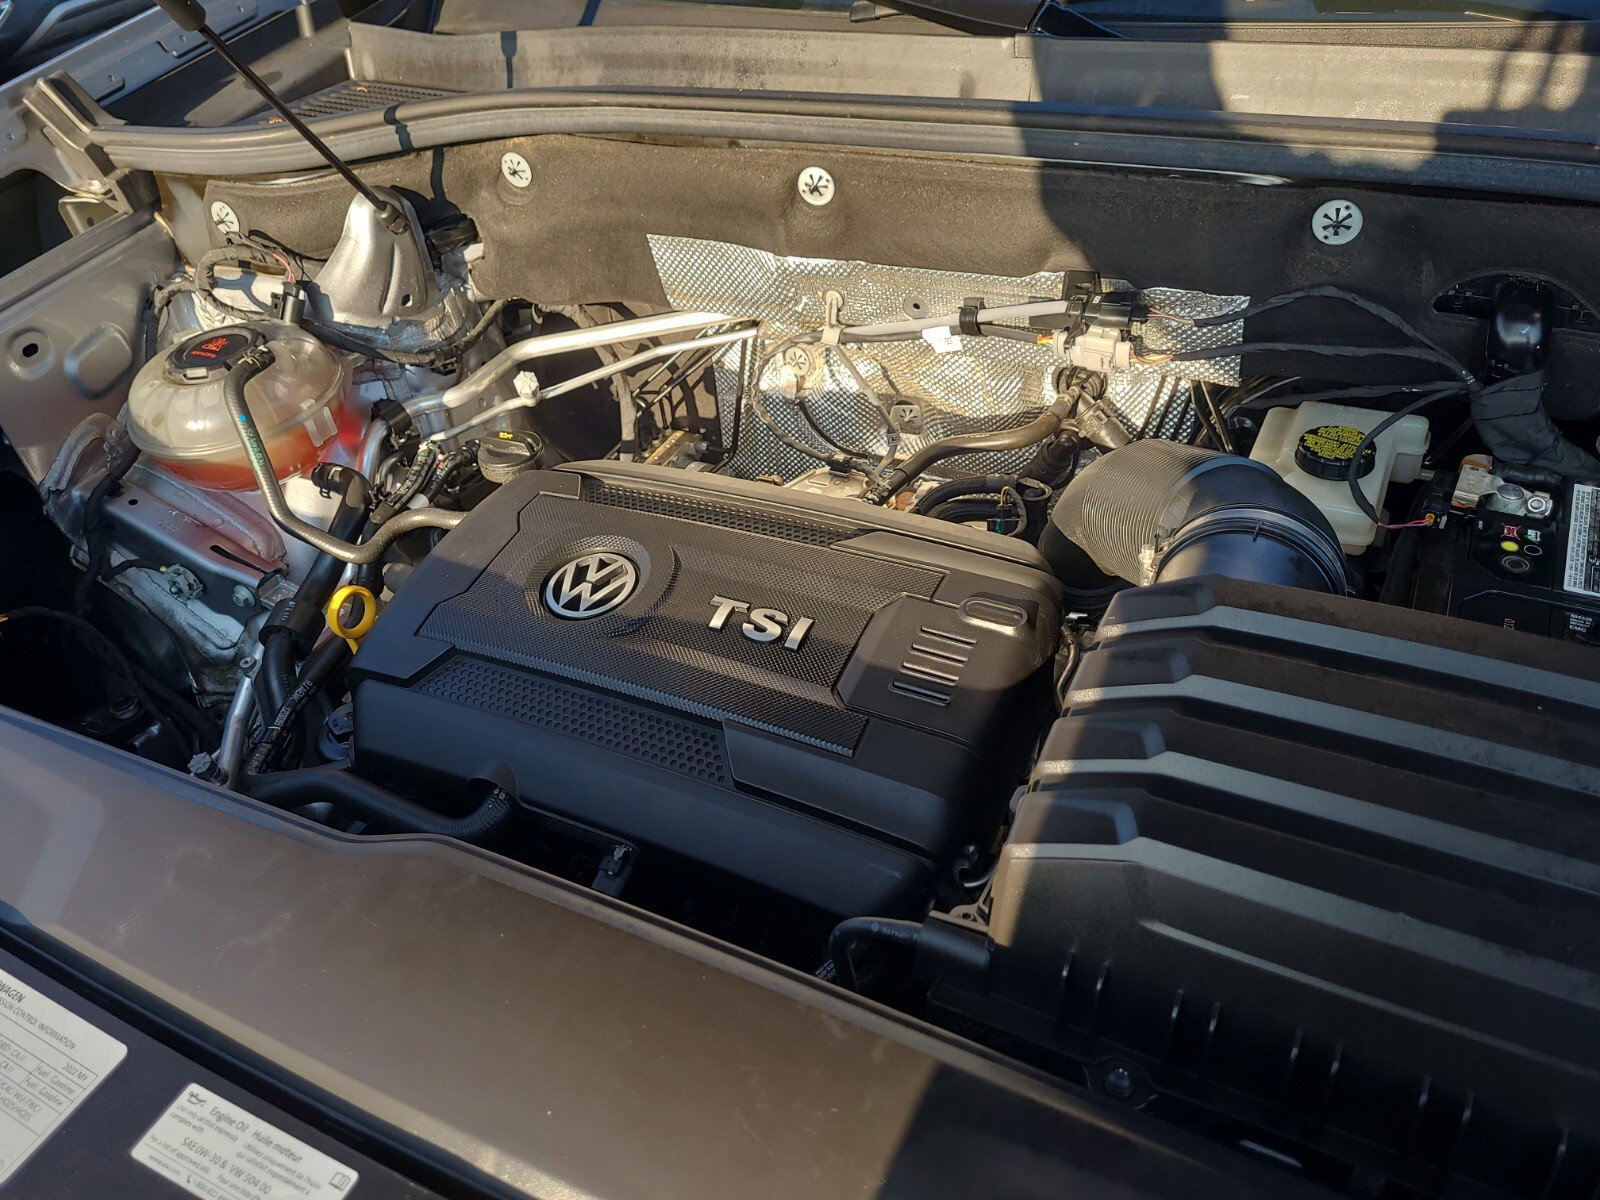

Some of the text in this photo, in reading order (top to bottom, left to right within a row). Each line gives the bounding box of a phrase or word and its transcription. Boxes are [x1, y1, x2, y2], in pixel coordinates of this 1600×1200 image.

[708, 594, 815, 651] TSI
[0, 980, 26, 1003] WAGEN
[0, 998, 76, 1050] SION CONTROL INFORMATION
[62, 1063, 79, 1077] 2022
[38, 1086, 64, 1107] Gasoline
[49, 1075, 75, 1095] Gasoline
[210, 1106, 303, 1163] Engine Oil Huile moteur
[229, 1163, 246, 1178] VW
[244, 1171, 260, 1187] 504
